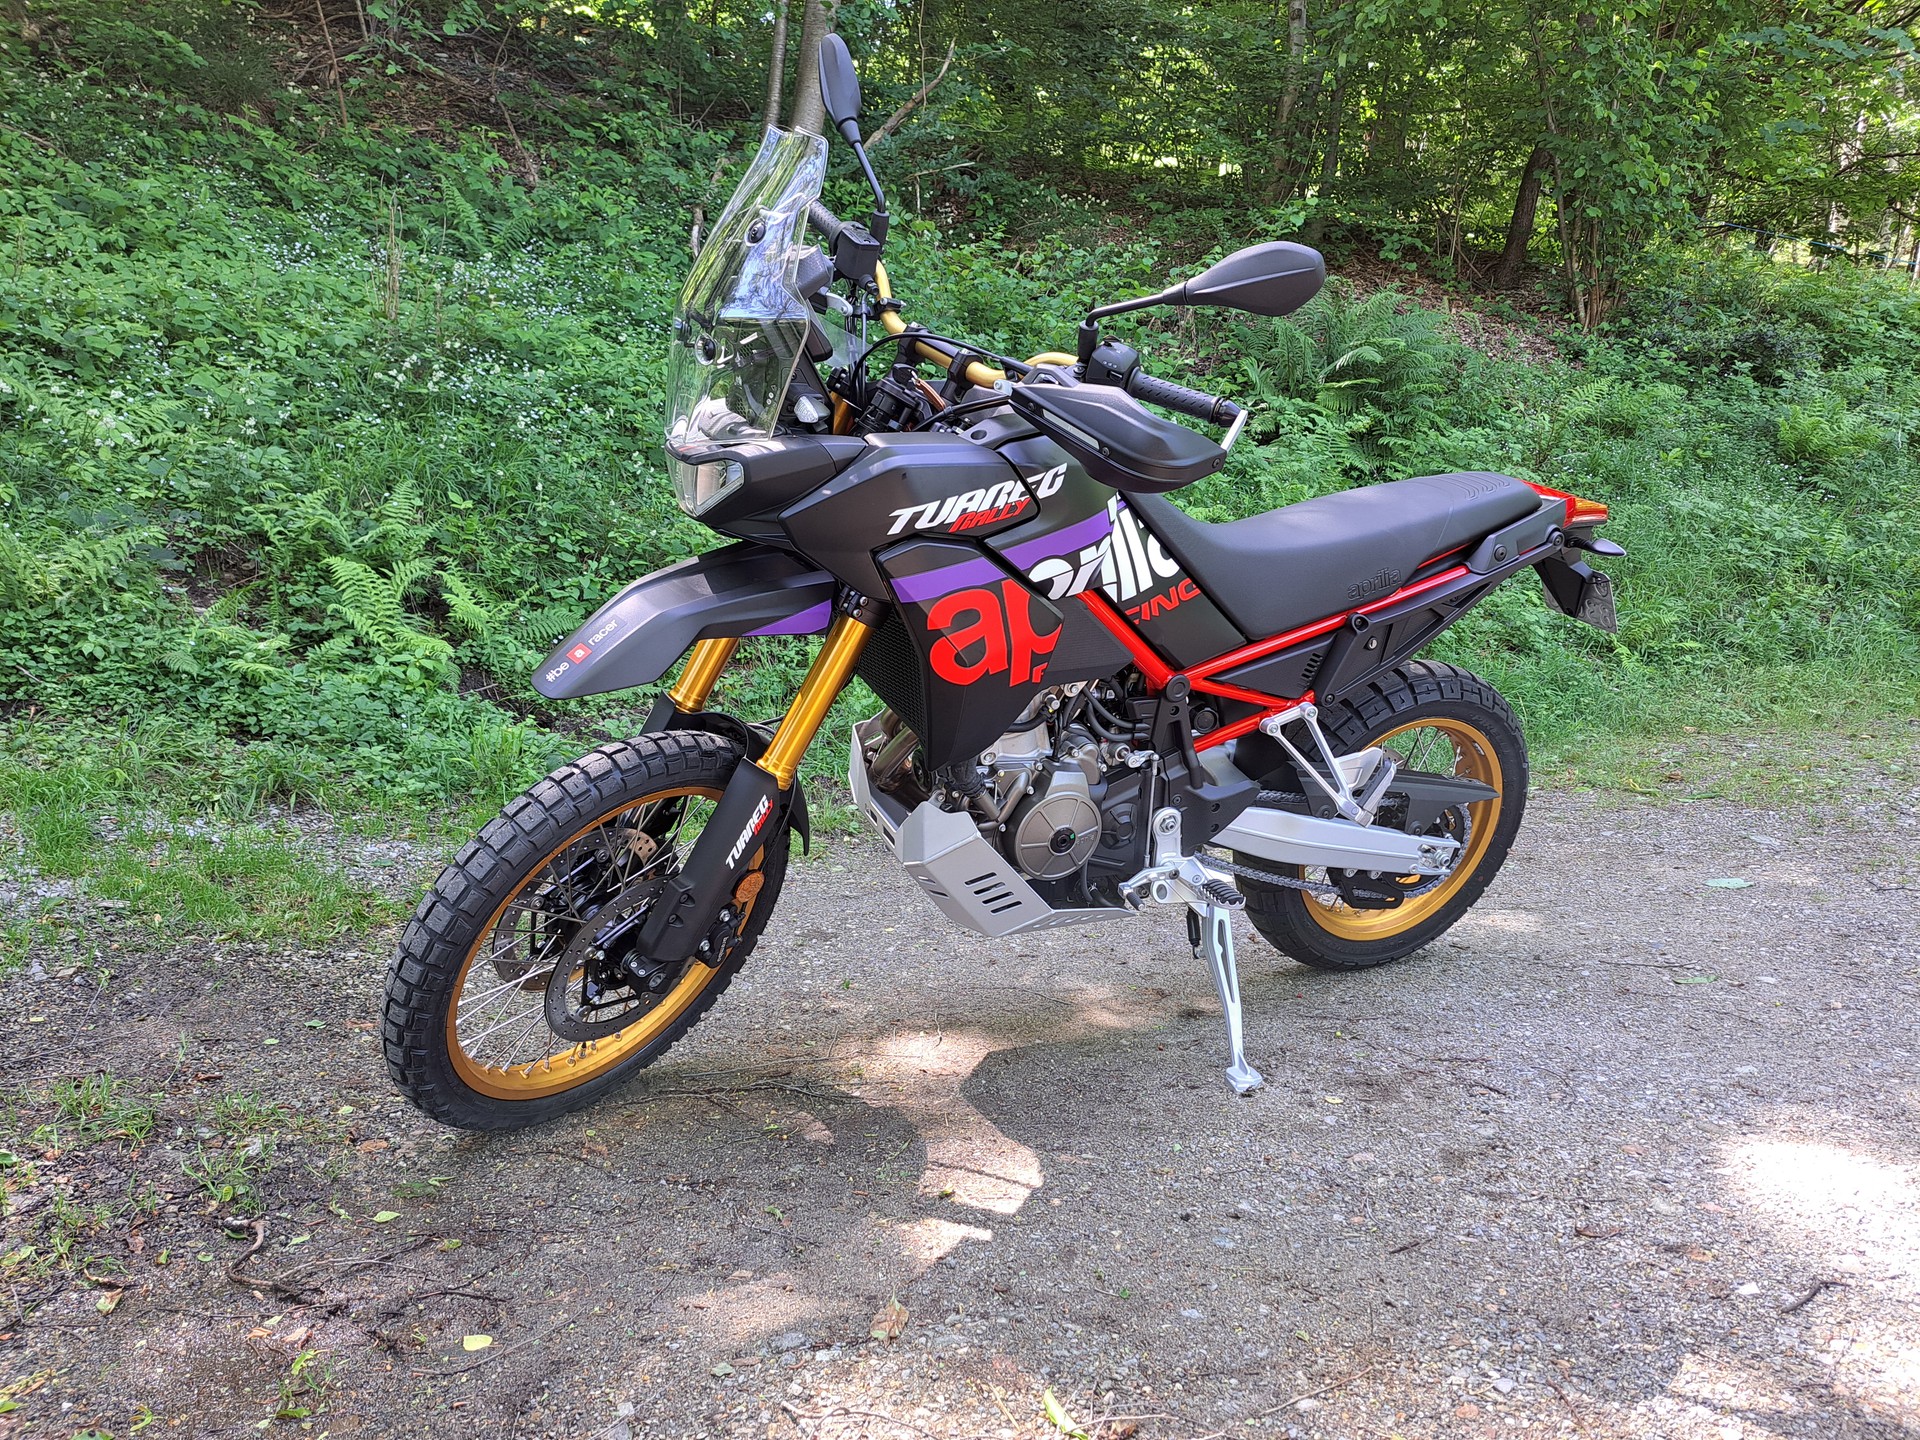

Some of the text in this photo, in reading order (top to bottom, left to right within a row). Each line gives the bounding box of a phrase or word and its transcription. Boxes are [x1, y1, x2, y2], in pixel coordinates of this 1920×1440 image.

[886, 463, 1068, 536] TUAREG
[948, 498, 1032, 533] RALLY
[1346, 567, 1402, 601] aprilia
[545, 661, 570, 682] #be
[587, 619, 619, 646] racer
[725, 794, 769, 870] TUAREG
